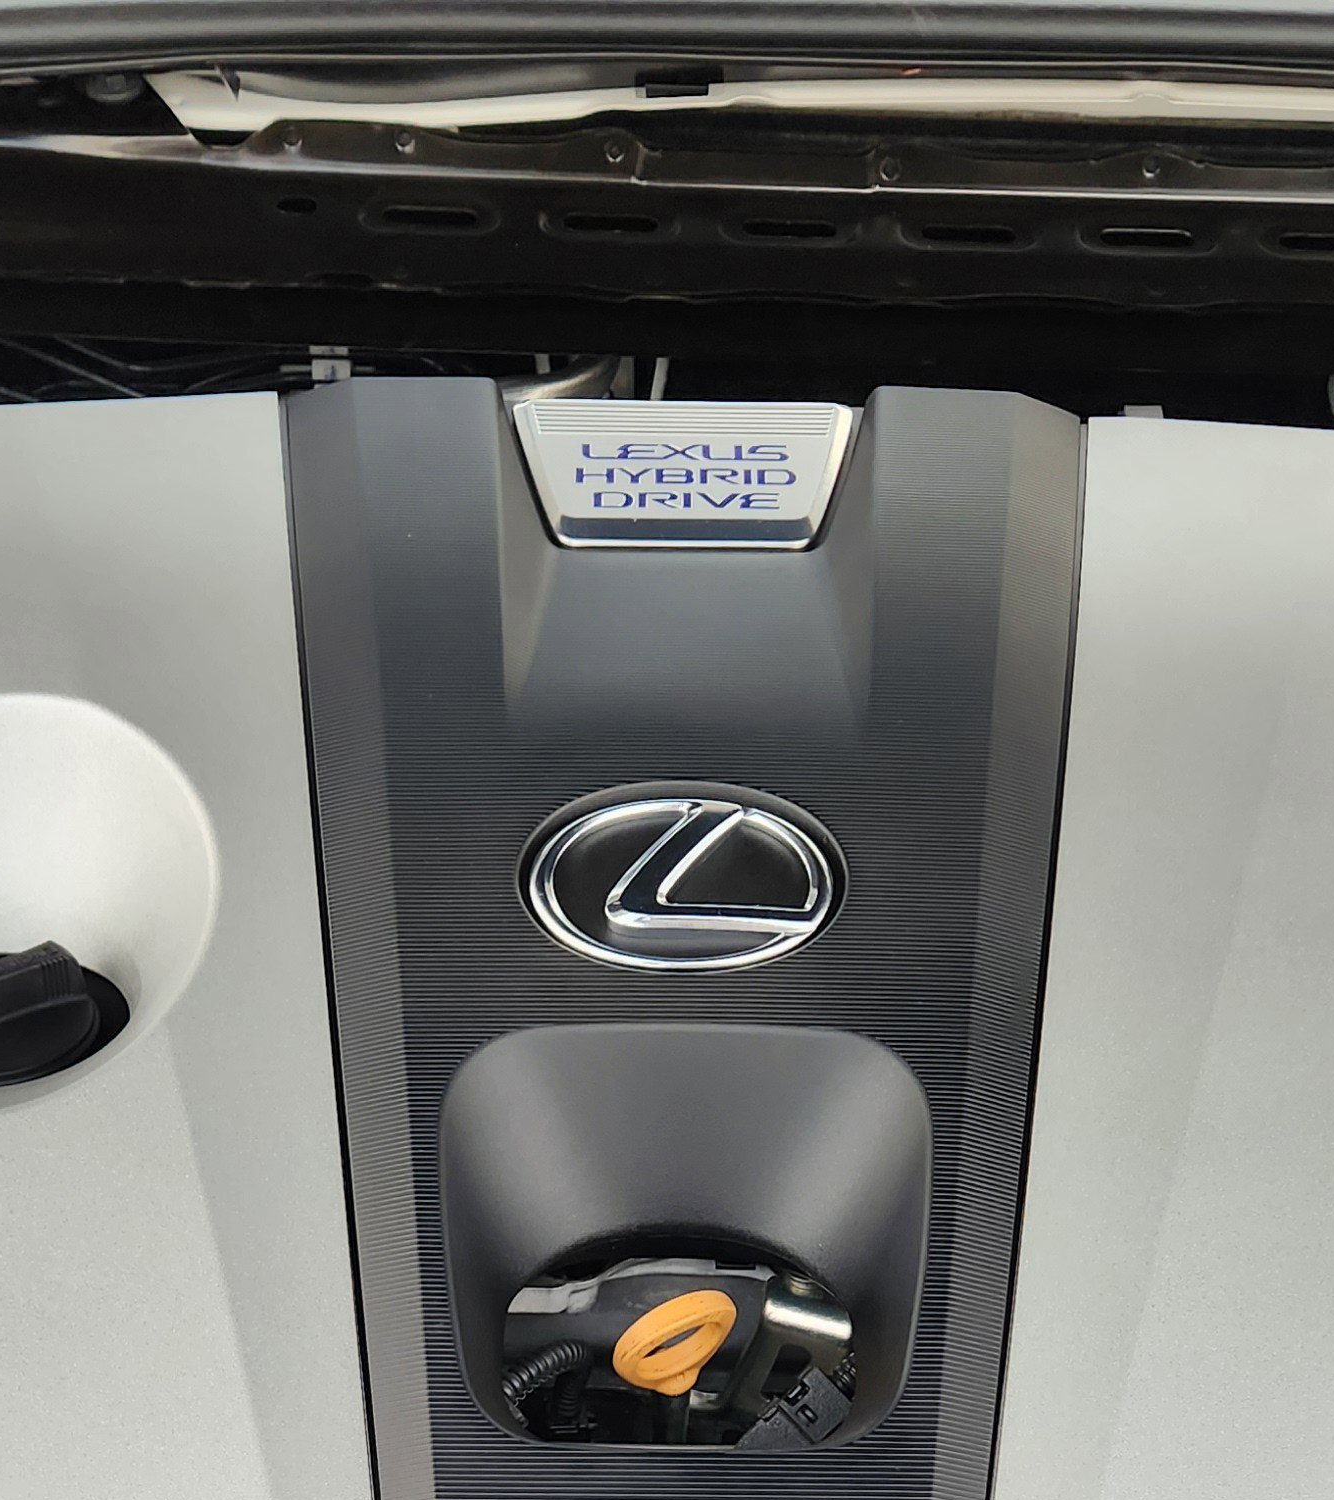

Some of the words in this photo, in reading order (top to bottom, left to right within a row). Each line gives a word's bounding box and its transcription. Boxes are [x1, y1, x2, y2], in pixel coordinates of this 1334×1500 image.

[582, 443, 789, 462] LEXUS
[575, 468, 797, 486] HYBRID
[593, 491, 780, 510] DRIVE
